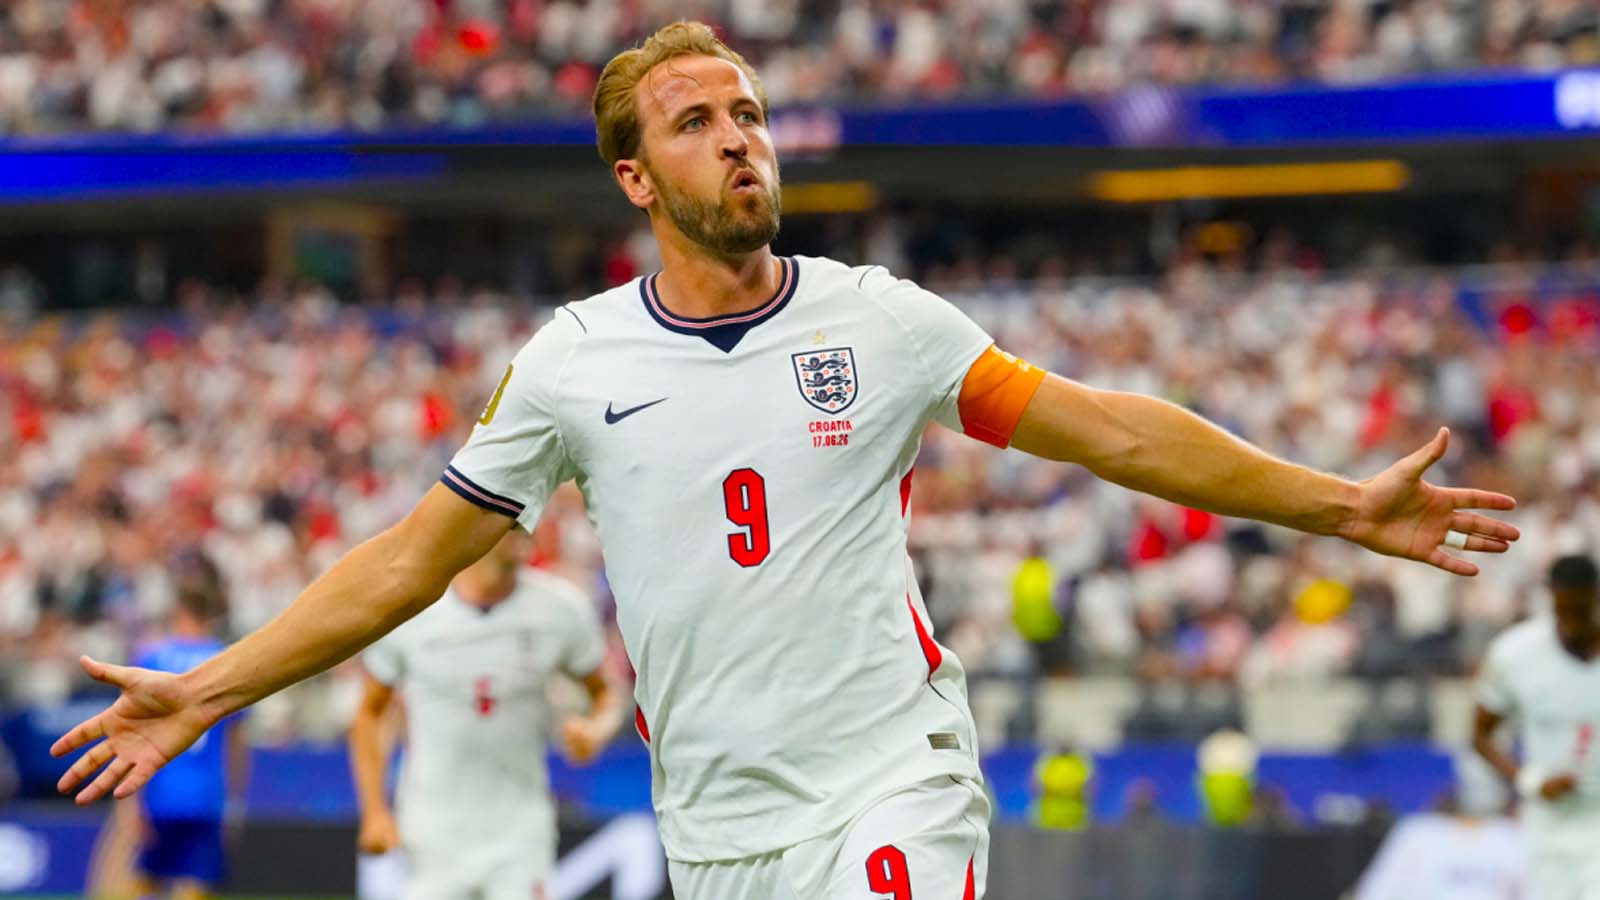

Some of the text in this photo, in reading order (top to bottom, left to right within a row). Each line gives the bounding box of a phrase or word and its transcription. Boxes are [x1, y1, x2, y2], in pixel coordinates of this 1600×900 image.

[808, 420, 853, 433] CROATIA
[813, 434, 848, 448] 17.06.26
[723, 468, 770, 568] 9
[865, 844, 912, 900] 9
